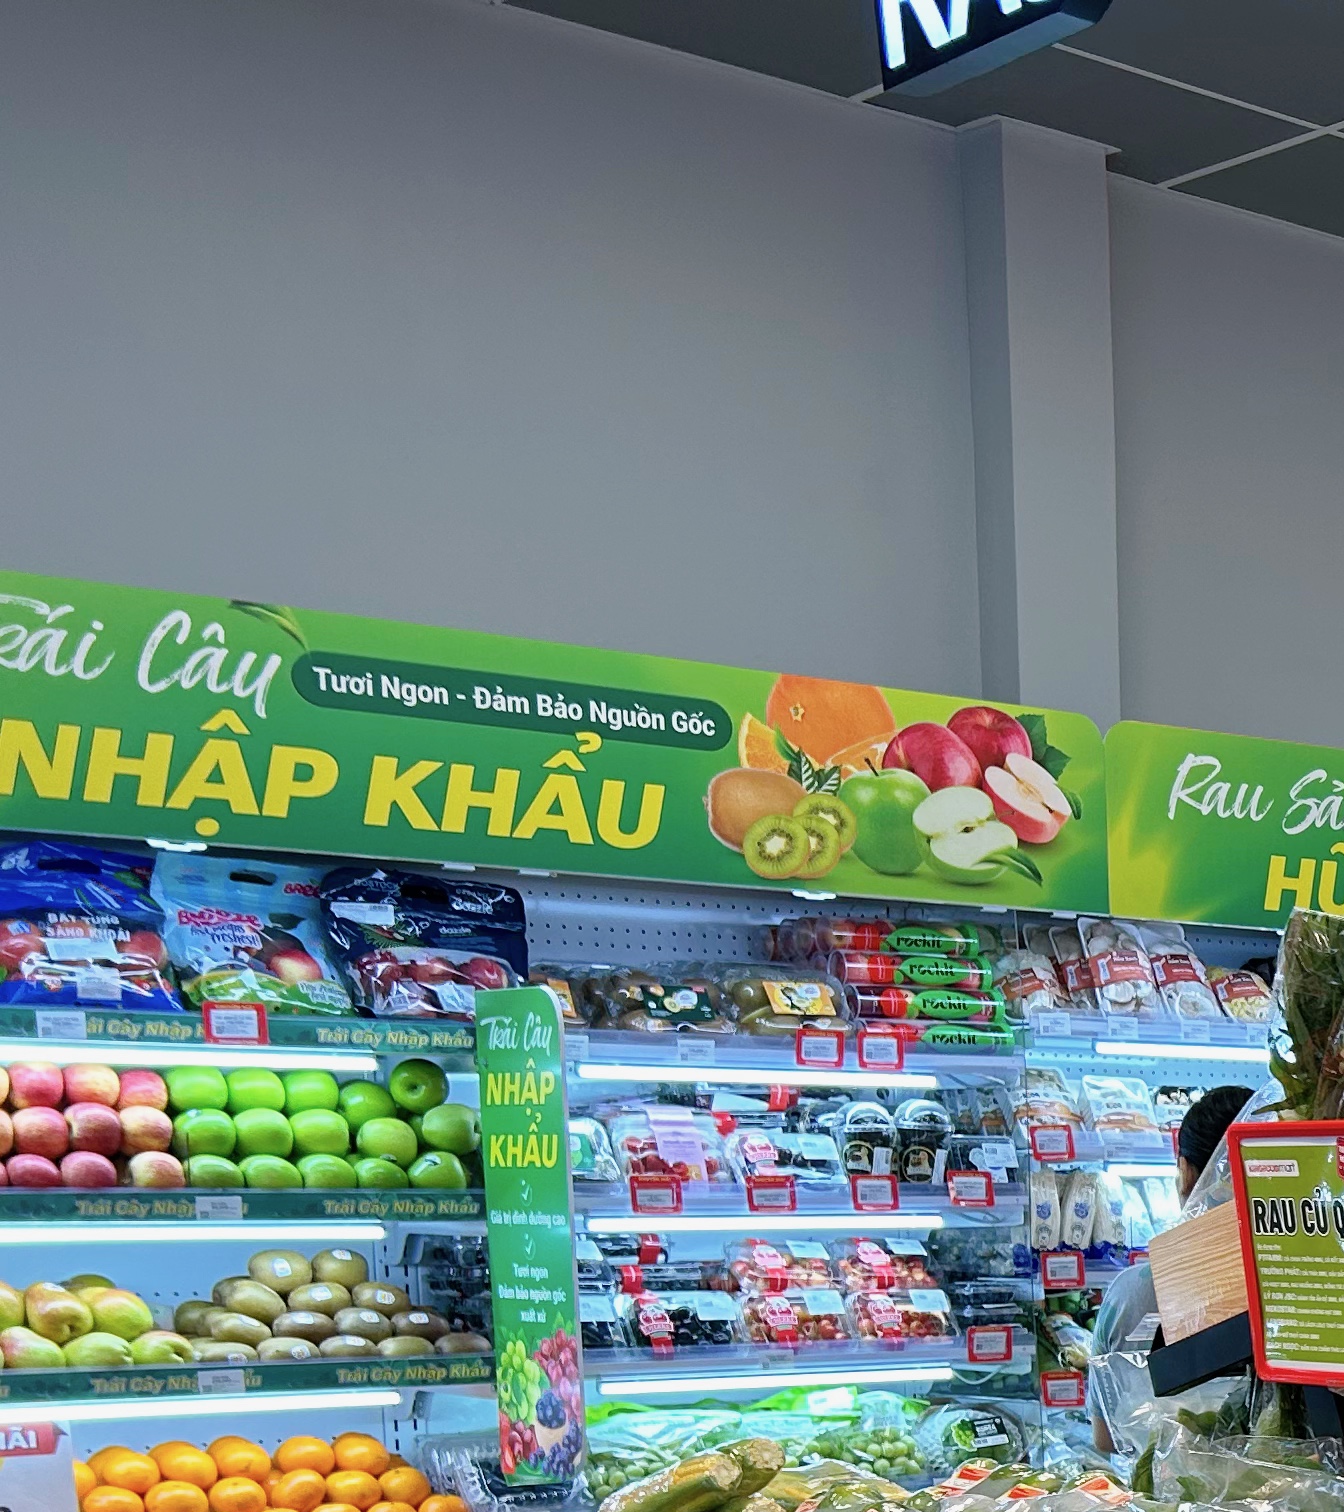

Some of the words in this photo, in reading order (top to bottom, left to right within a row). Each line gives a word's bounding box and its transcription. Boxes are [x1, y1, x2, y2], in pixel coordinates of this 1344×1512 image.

[137, 609, 283, 720] Cây
[311, 664, 374, 699] Tươi
[380, 675, 450, 707] Ngon
[471, 682, 530, 716] Đảm
[536, 690, 583, 722] Bảo
[589, 701, 666, 735] Nguồn
[671, 706, 716, 738] Gốc
[0, 708, 340, 838] NHẬP
[362, 731, 666, 851] KHẨU
[1168, 753, 1276, 821] Rau
[895, 932, 943, 950] rockit
[907, 961, 956, 979] rockit
[922, 995, 968, 1011] rockit
[317, 1027, 348, 1044] Trái
[387, 1028, 427, 1048] Nhập
[431, 1022, 474, 1047] Khẩu
[480, 1016, 519, 1050] Trái
[523, 1011, 553, 1056] Cây
[931, 1030, 978, 1047] rockit
[486, 1057, 555, 1116] NHẬP
[490, 1112, 559, 1169] KHẨU
[1252, 1198, 1297, 1236] RAU
[1300, 1186, 1330, 1237] CỦ
[0, 1426, 37, 1451] ÃI
